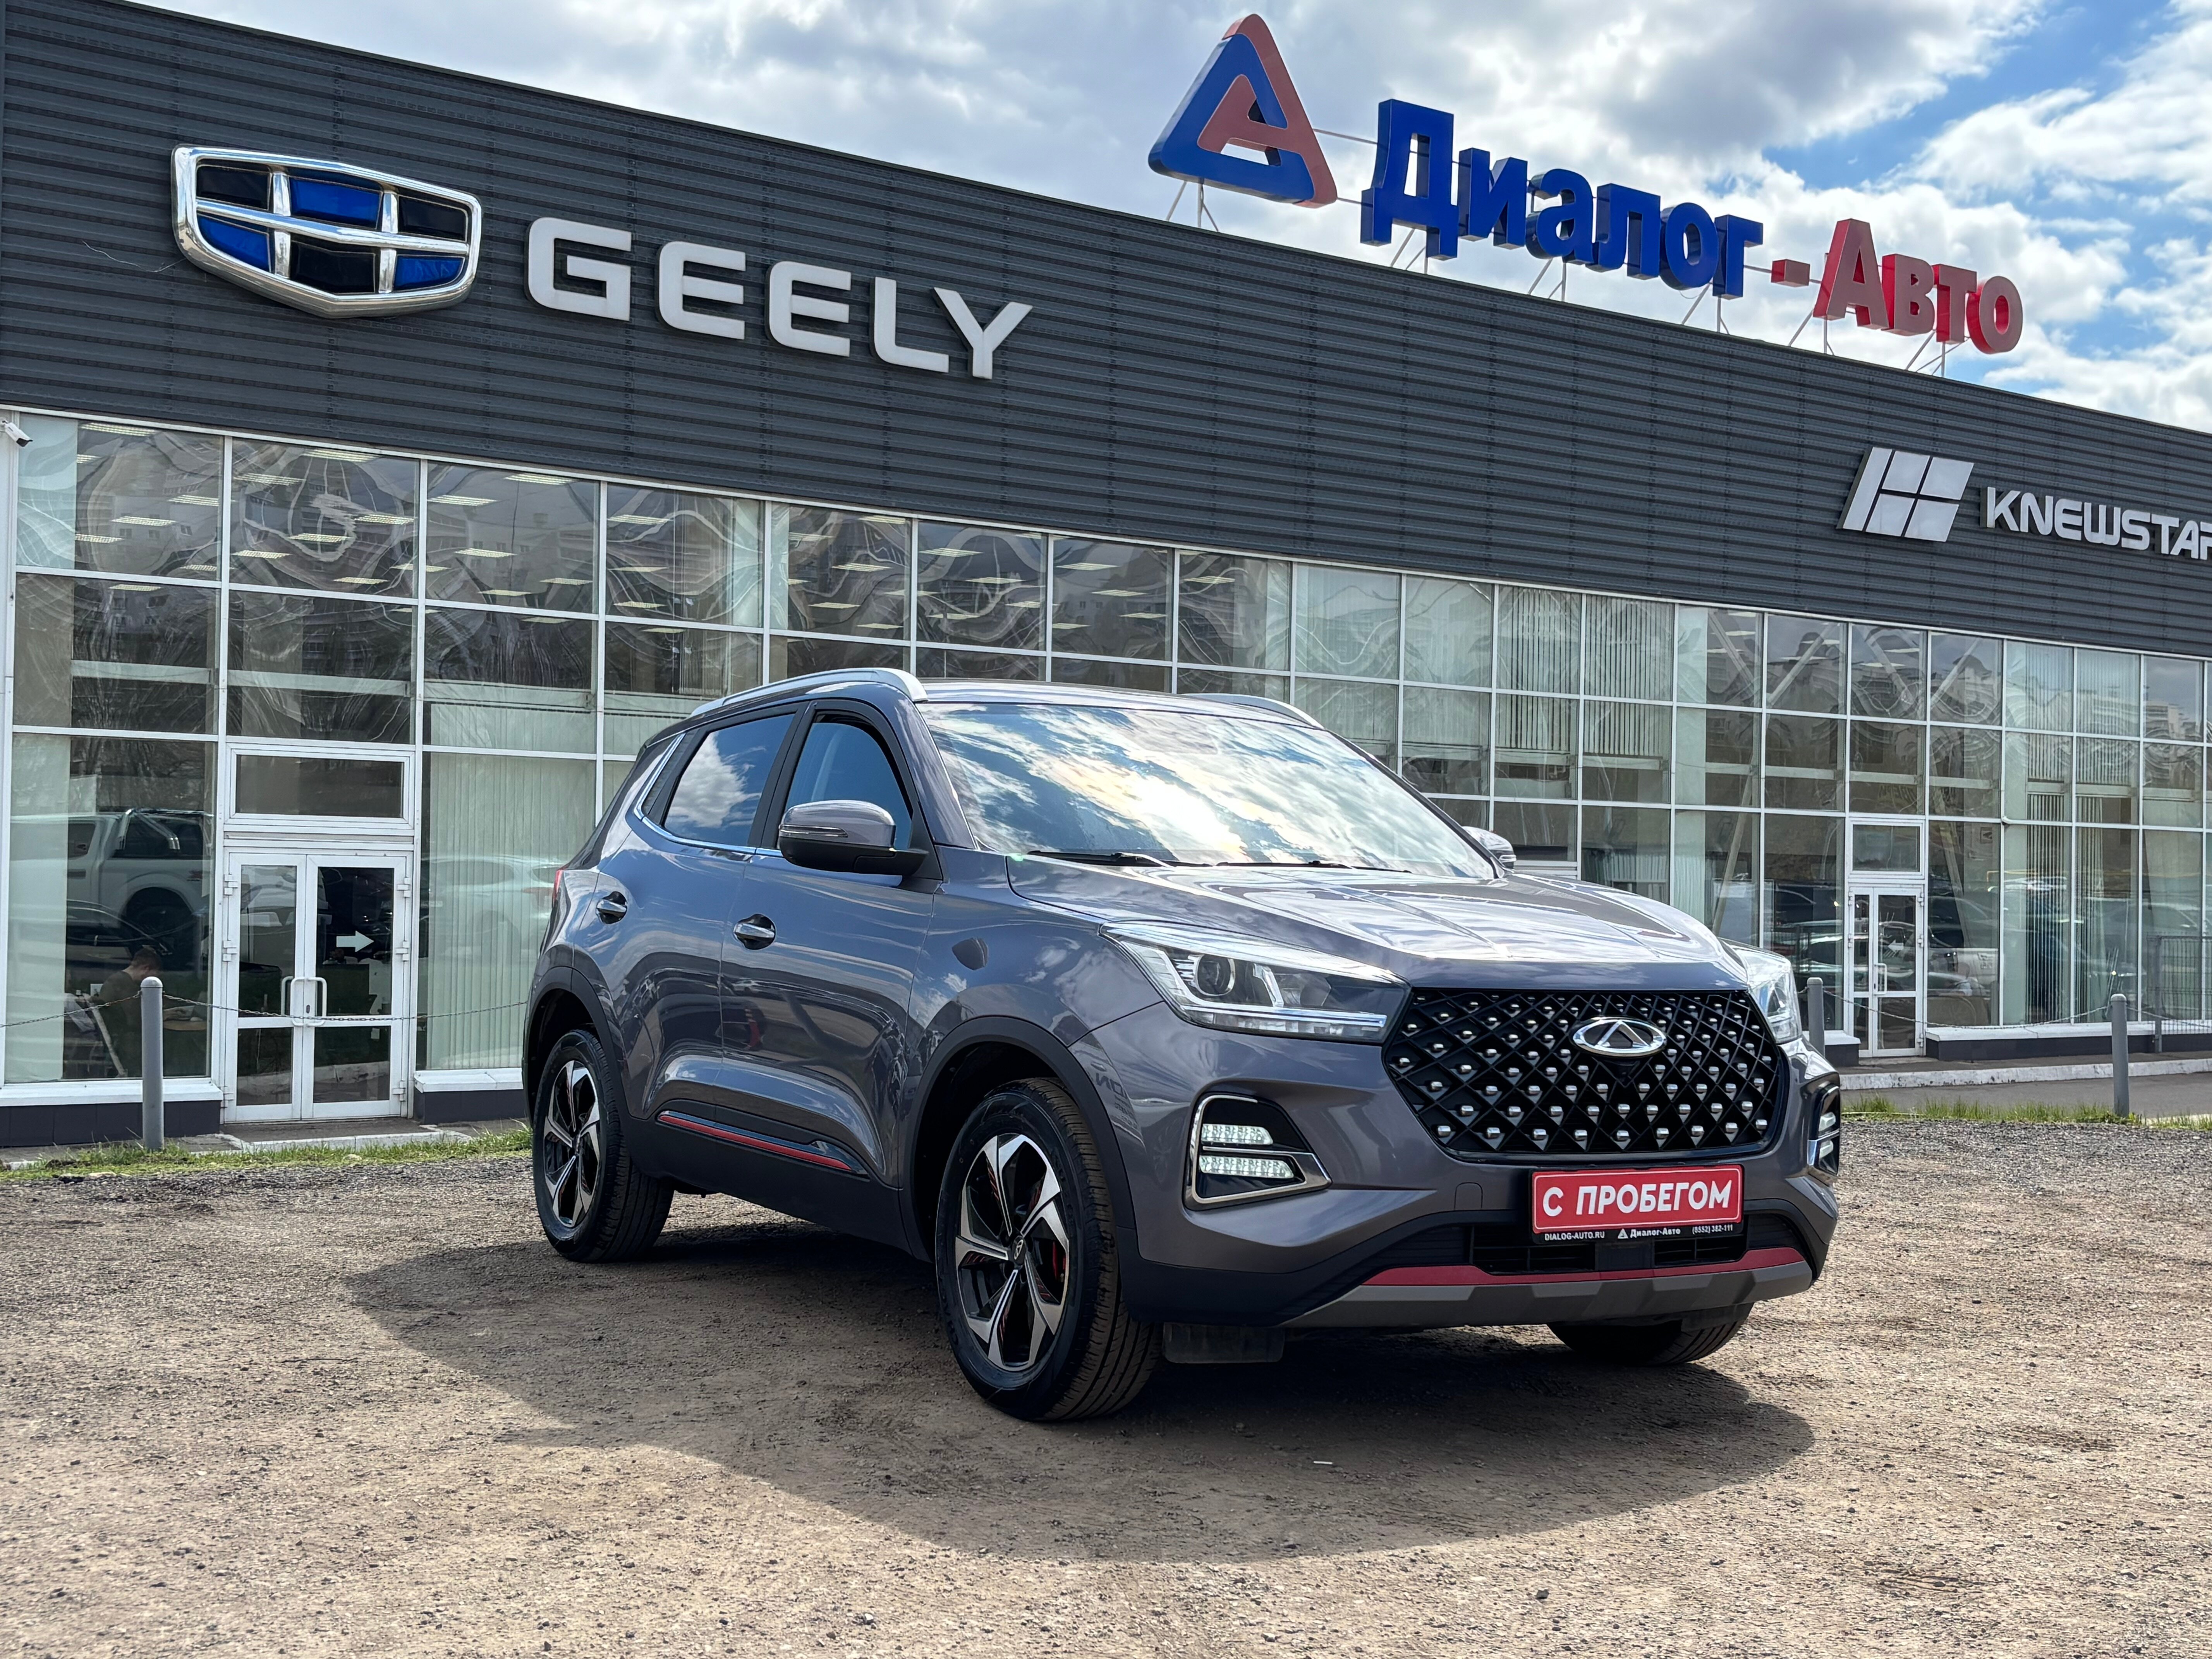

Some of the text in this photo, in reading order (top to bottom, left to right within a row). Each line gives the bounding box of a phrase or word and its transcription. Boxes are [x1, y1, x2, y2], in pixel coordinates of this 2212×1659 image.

[526, 217, 1033, 380] GEELY
[1542, 1180, 1733, 1217] С ПРОБЕГОМ
[1544, 1231, 1605, 1241] DIALOG-AUTO.RU
[1630, 1228, 1681, 1238] Диалог-Авто
